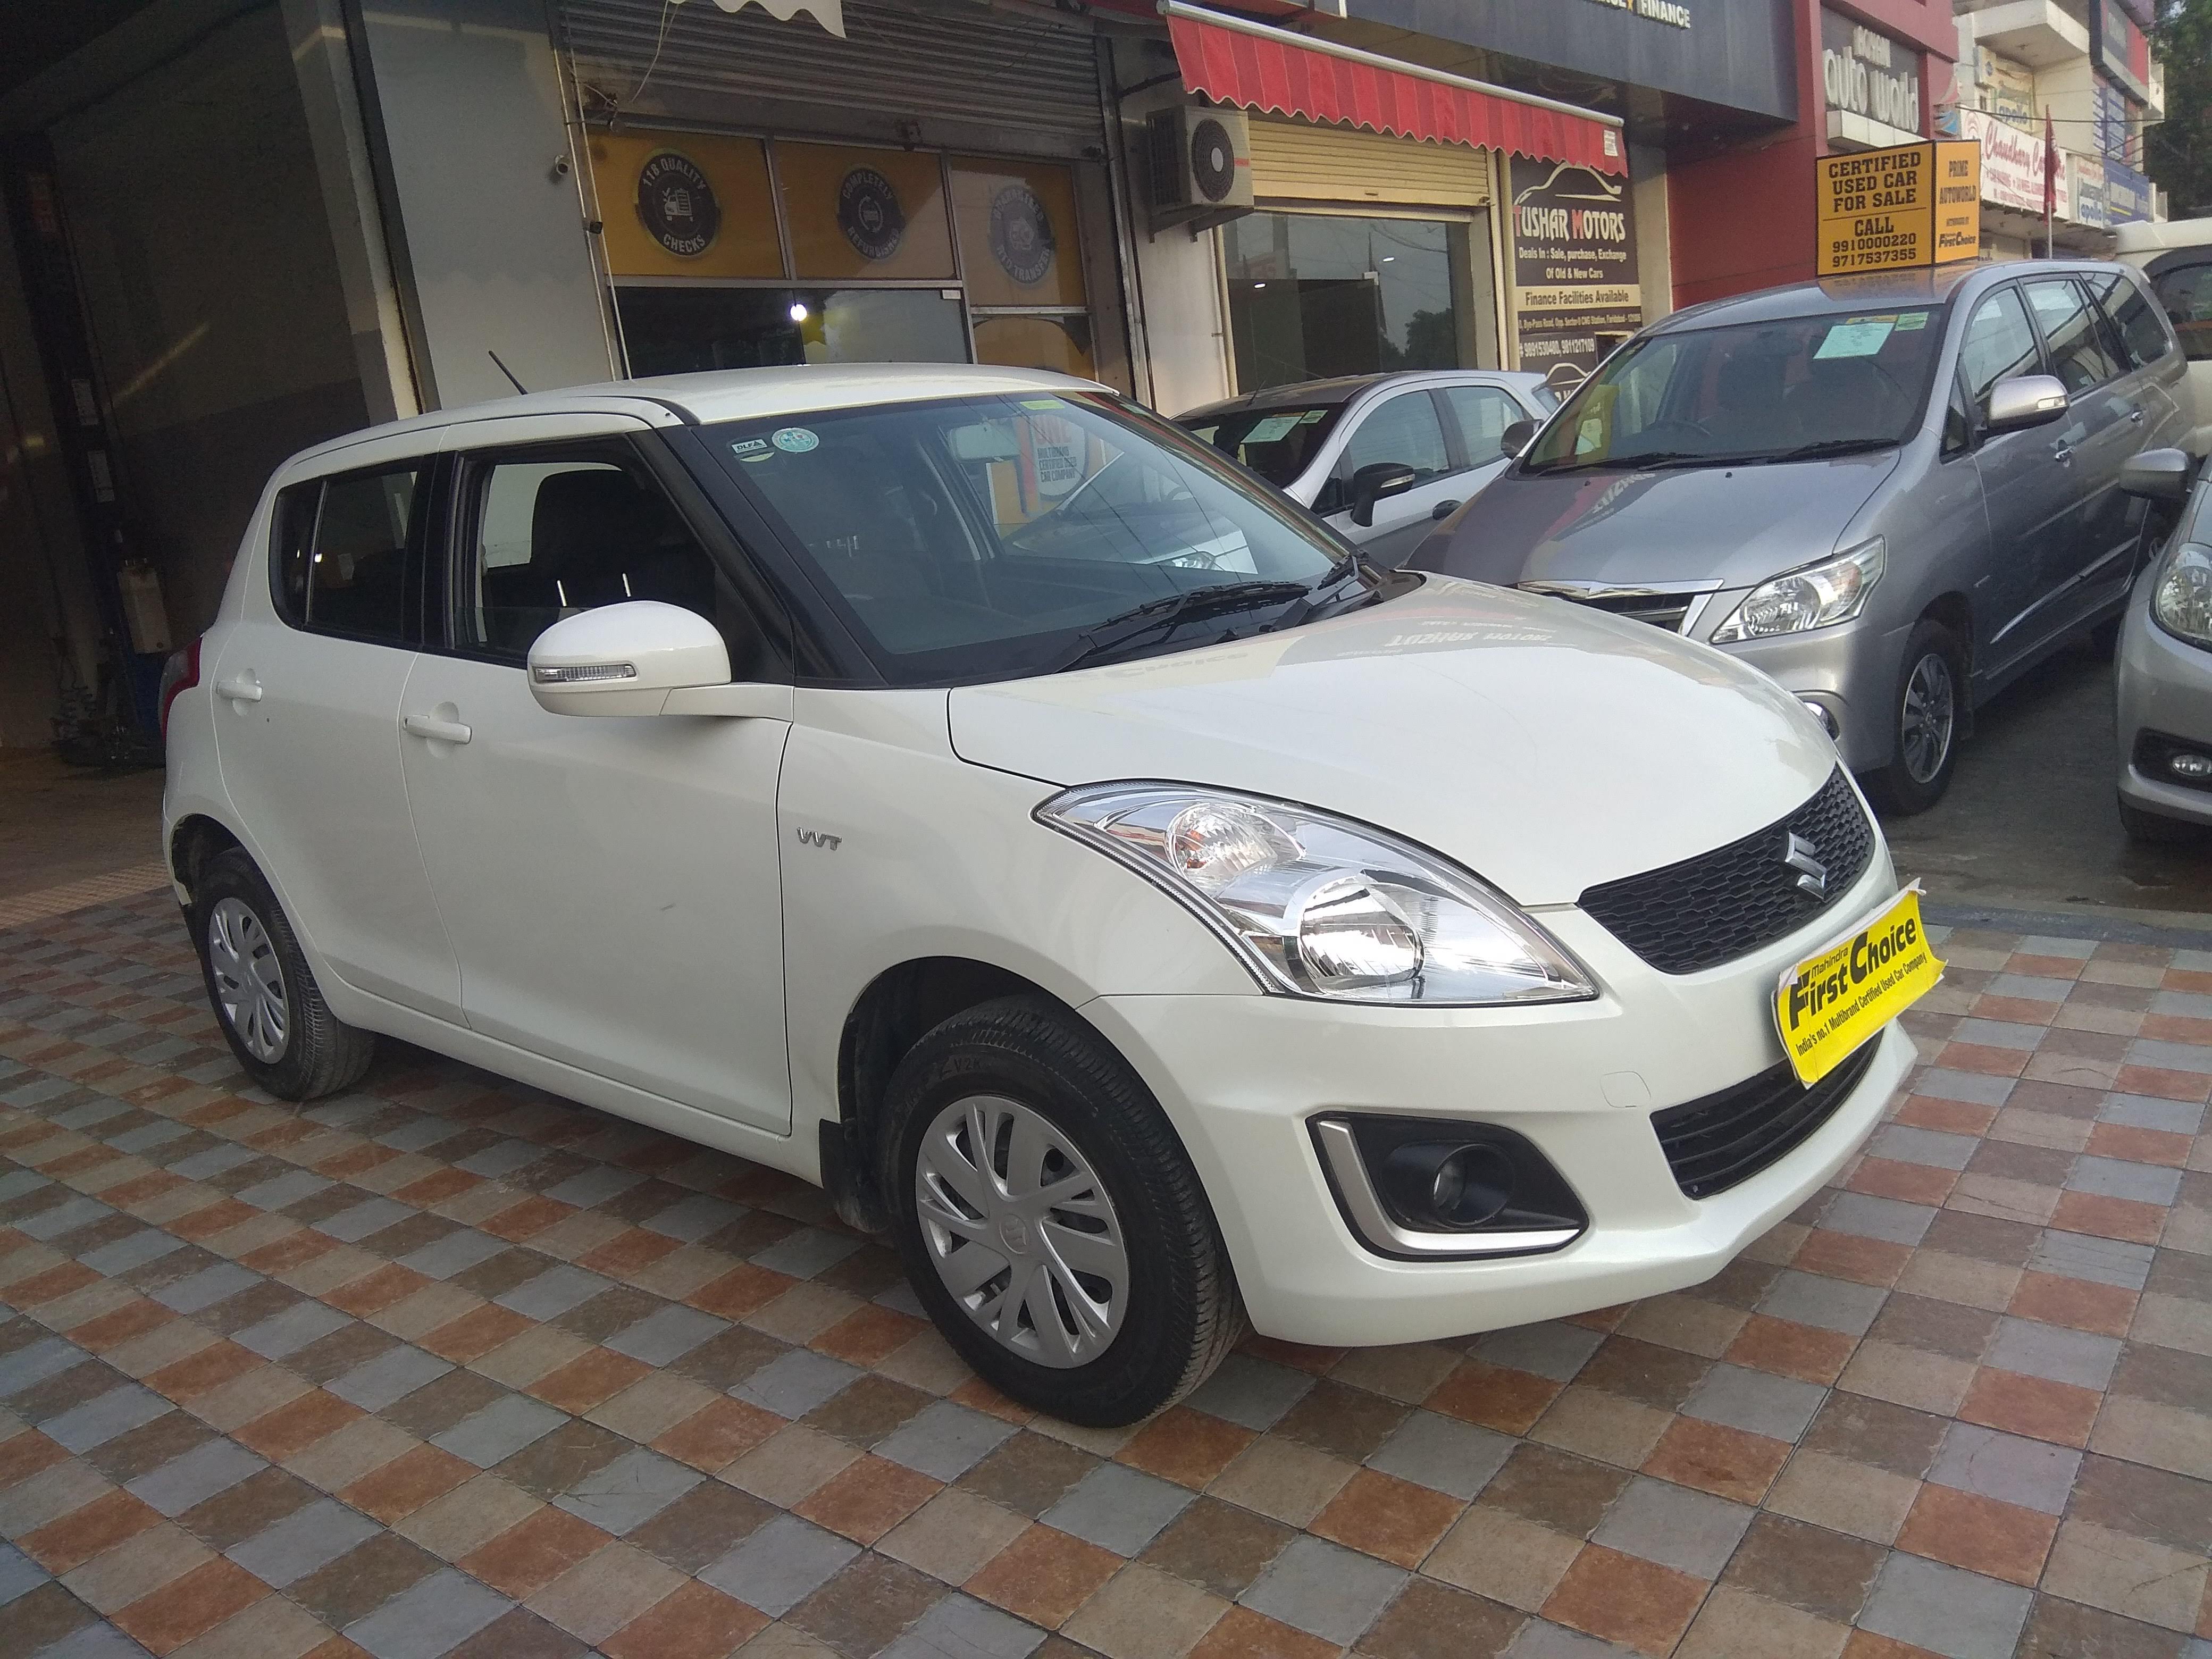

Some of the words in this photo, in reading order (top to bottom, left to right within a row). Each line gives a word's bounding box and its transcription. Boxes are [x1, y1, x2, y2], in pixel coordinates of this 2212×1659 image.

[1640, 0, 1691, 28] FINANCE
[643, 163, 660, 186] 118
[660, 157, 706, 189] QUALITY
[1829, 152, 1921, 179] CERTIFIED
[1949, 160, 1968, 178] PRIME
[842, 172, 895, 199] COMPLETELY
[1832, 176, 1877, 195] USED
[1884, 171, 1917, 188] CAR
[1939, 185, 1976, 204] AUTOWORLD
[1833, 195, 1866, 213] FOR
[1872, 188, 1916, 207] SALE
[1514, 205, 1570, 241] TUSHAR
[1571, 209, 1626, 243] MOTORS
[1855, 216, 1894, 237] CALL
[664, 233, 705, 253] CHECKS
[847, 226, 899, 257] REFURBISHED
[1832, 233, 1916, 253] 9910000220
[1013, 248, 1051, 281] TRANSFER
[1519, 247, 1538, 258] Deals
[1598, 248, 1627, 262] Exchange
[1832, 248, 1916, 267] 9717537355
[1546, 267, 1554, 279] Of
[1555, 267, 1566, 279] Old
[1567, 268, 1572, 279] &
[1573, 268, 1588, 279] New
[1589, 267, 1604, 279] Cars
[1526, 291, 1557, 305] Finance
[1559, 291, 1594, 305] Facilities
[1595, 290, 1629, 304] Available
[1041, 471, 1051, 483] CAR
[1051, 469, 1075, 481] COMPANY
[1812, 946, 1848, 979] Mahindra
[1796, 1034, 1817, 1057] India's
[1817, 1023, 1830, 1040] no.1
[1829, 1001, 1860, 1030] Multibrand
[1859, 985, 1882, 1009] Certified
[1882, 975, 1896, 991] Used
[1895, 968, 1905, 981] Car
[1904, 952, 1928, 975] Company
